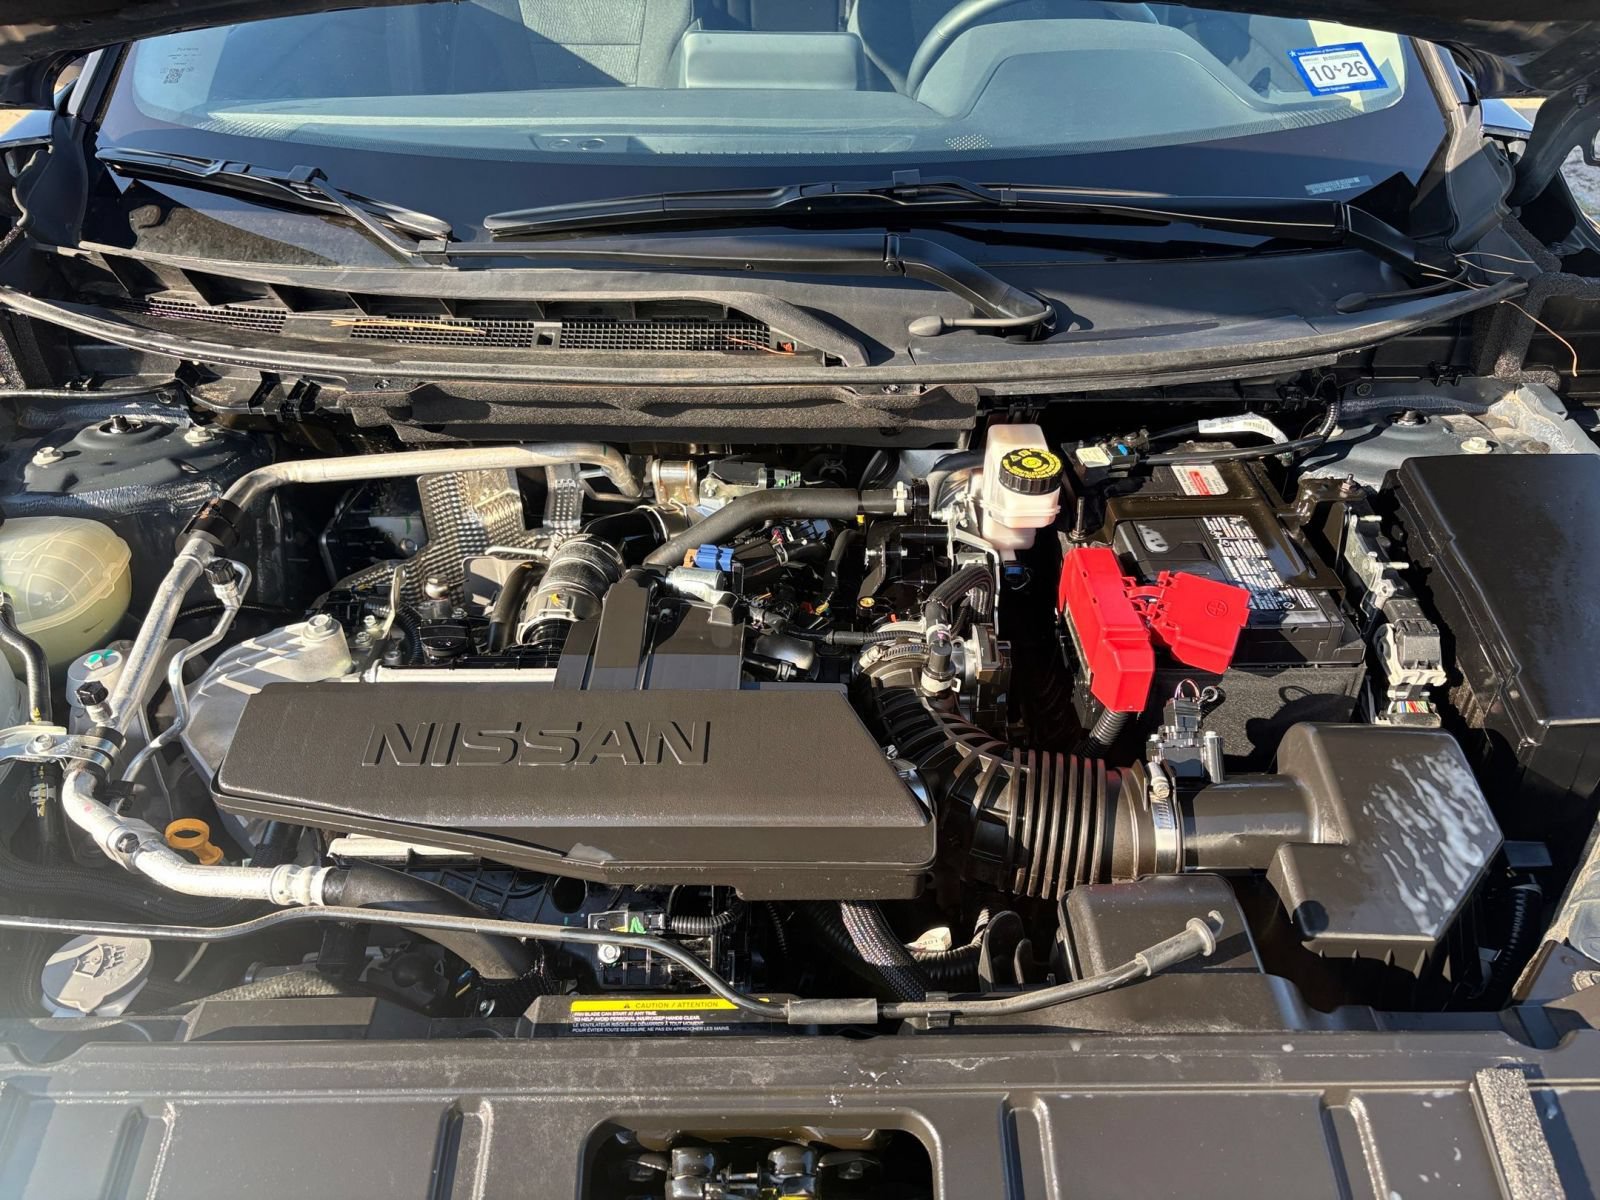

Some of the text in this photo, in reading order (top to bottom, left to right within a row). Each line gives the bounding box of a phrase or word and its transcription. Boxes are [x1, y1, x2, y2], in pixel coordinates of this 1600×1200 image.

[1310, 60, 1369, 81] 10 26
[361, 721, 711, 767] NISSAN
